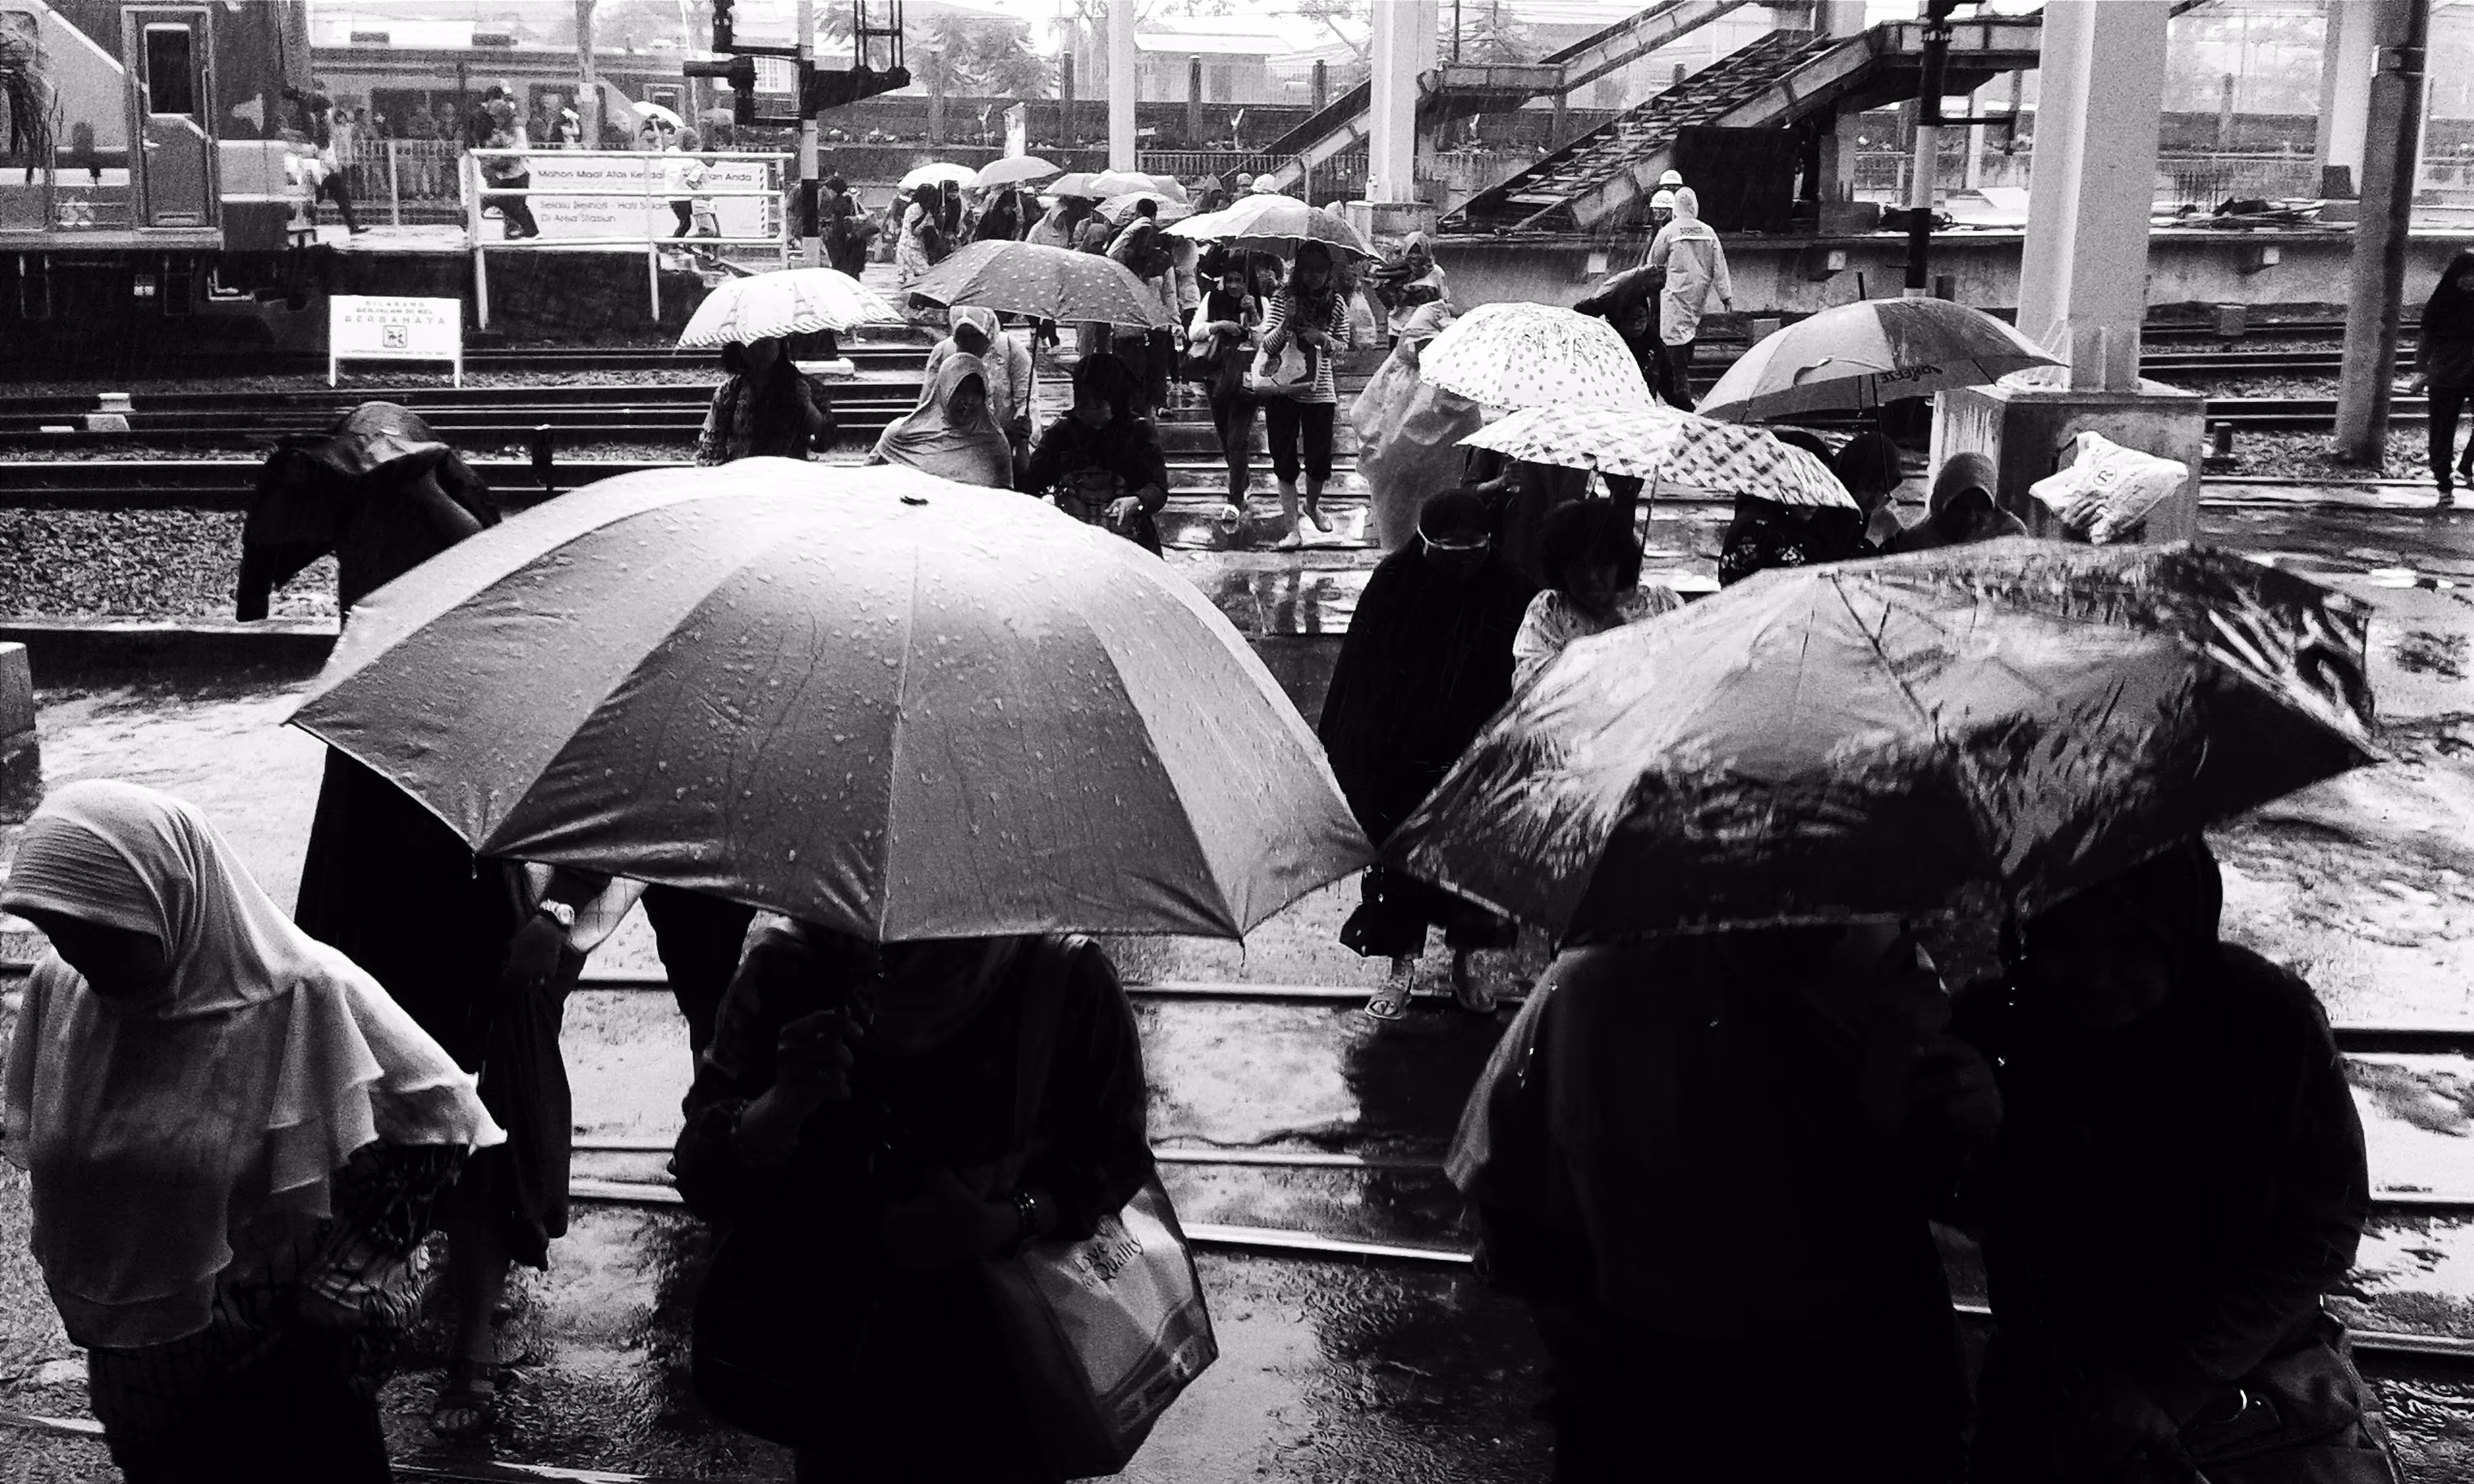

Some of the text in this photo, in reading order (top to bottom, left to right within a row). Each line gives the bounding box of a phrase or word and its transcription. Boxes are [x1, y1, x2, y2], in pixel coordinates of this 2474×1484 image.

[725, 173, 752, 181] Anda
[344, 315, 445, 325] BERBAHAYA
[1094, 1234, 1144, 1280] Quality
